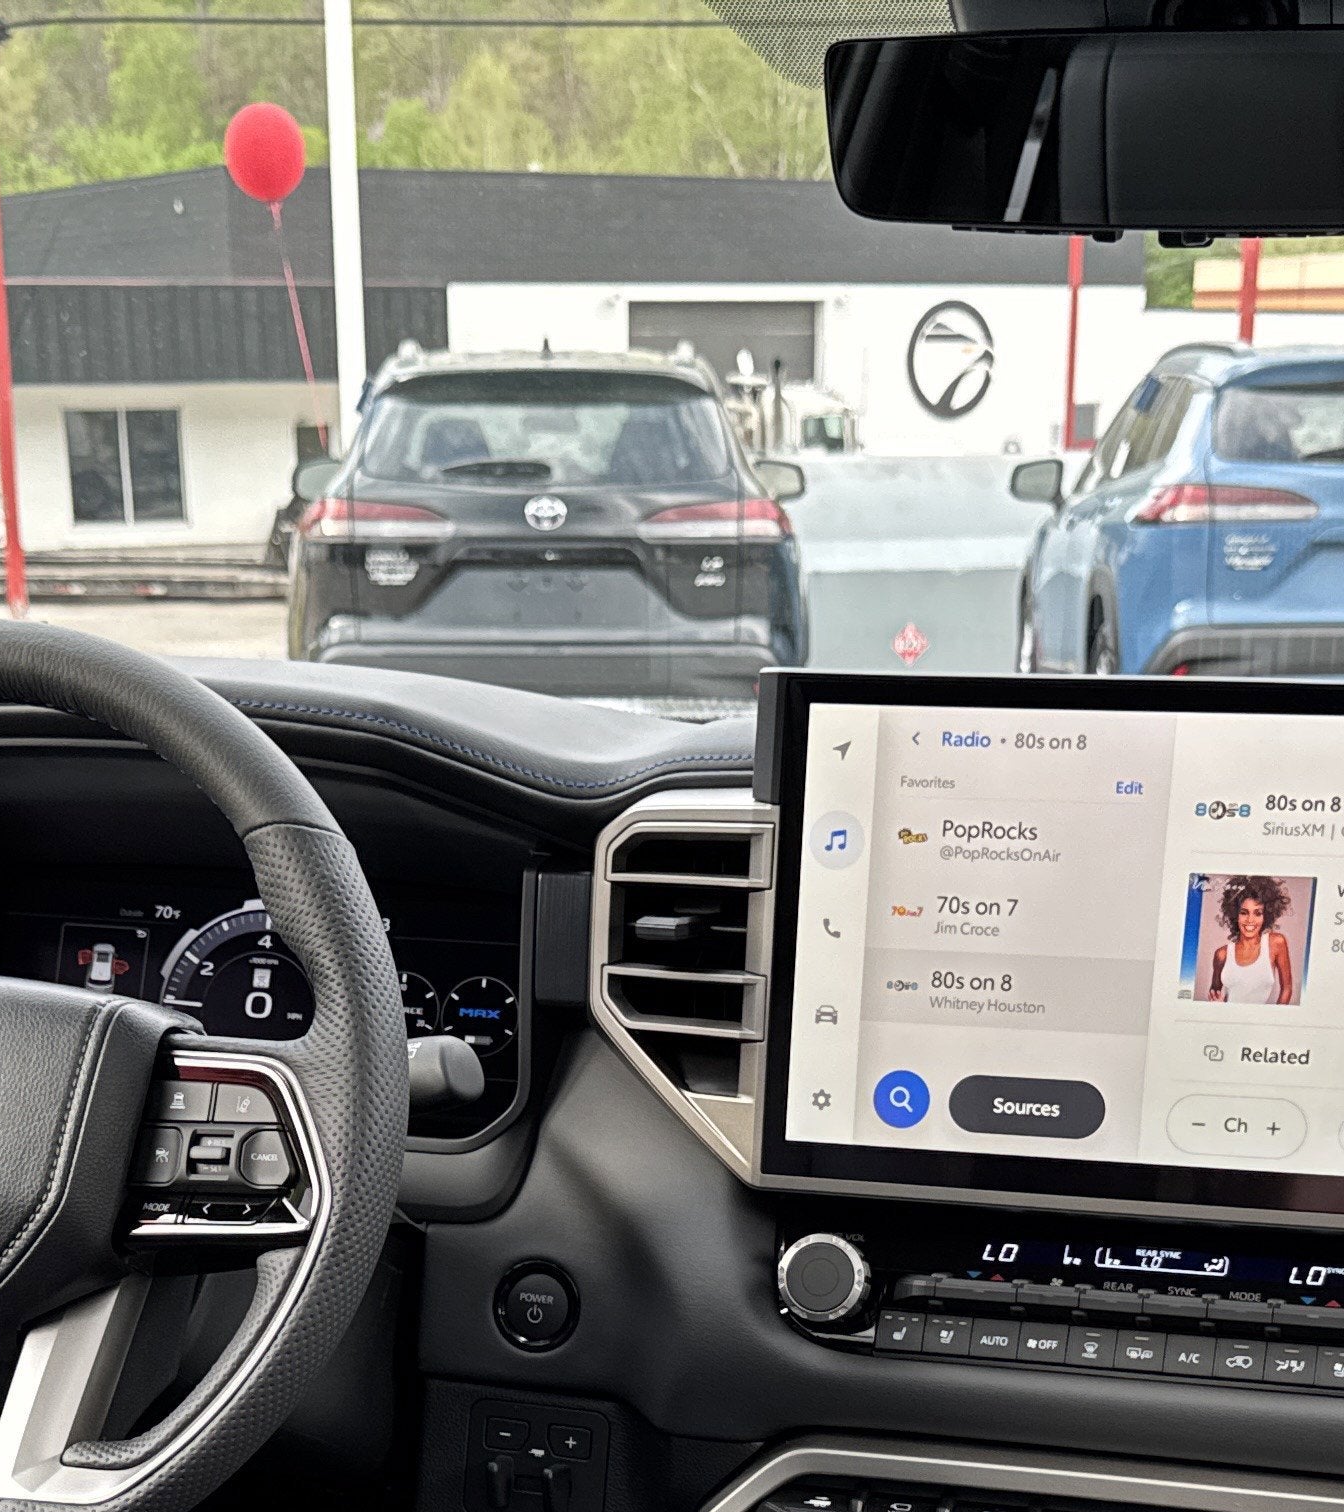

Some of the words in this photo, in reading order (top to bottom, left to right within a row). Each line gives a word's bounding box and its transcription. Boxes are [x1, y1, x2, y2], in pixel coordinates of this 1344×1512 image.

[941, 731, 991, 748] Radio
[1014, 733, 1045, 749] 80s
[1049, 736, 1071, 749] on
[1076, 735, 1087, 750] 8
[900, 776, 955, 789] Favorites
[1116, 781, 1143, 795] Edit
[1265, 795, 1298, 812] 80s
[1301, 799, 1325, 813] on
[1330, 796, 1341, 813] 8
[942, 820, 1038, 845] PopRocks
[1262, 822, 1324, 838] SiriusXM
[939, 846, 1061, 863] @PopRocksOnAir
[937, 896, 970, 915] 70s
[976, 901, 1001, 916] on
[1007, 899, 1019, 917] 7
[934, 922, 957, 936] Jim
[960, 923, 1000, 937] Croce
[257, 934, 273, 949] 4
[200, 963, 213, 976] 2
[931, 971, 965, 990] 80s
[970, 977, 995, 991] on
[1000, 974, 1012, 992] 8
[244, 991, 273, 1019] 0
[929, 996, 984, 1013] Whitney
[987, 998, 1045, 1014] Houston
[459, 1007, 499, 1020] MAX
[1240, 1047, 1310, 1066] Related
[993, 1097, 1060, 1117] Sources
[1224, 1118, 1248, 1134] Ch
[143, 1203, 170, 1212] MODE
[982, 1243, 1019, 1264] LO
[1289, 1266, 1327, 1286] LO
[1103, 1281, 1133, 1292] REAR
[1167, 1286, 1197, 1297] SYNC
[519, 1292, 554, 1304] POWER
[1229, 1291, 1262, 1302] MODE
[979, 1335, 1009, 1347] AUTO
[1038, 1339, 1058, 1350] OFF
[1178, 1352, 1200, 1363] A/C
